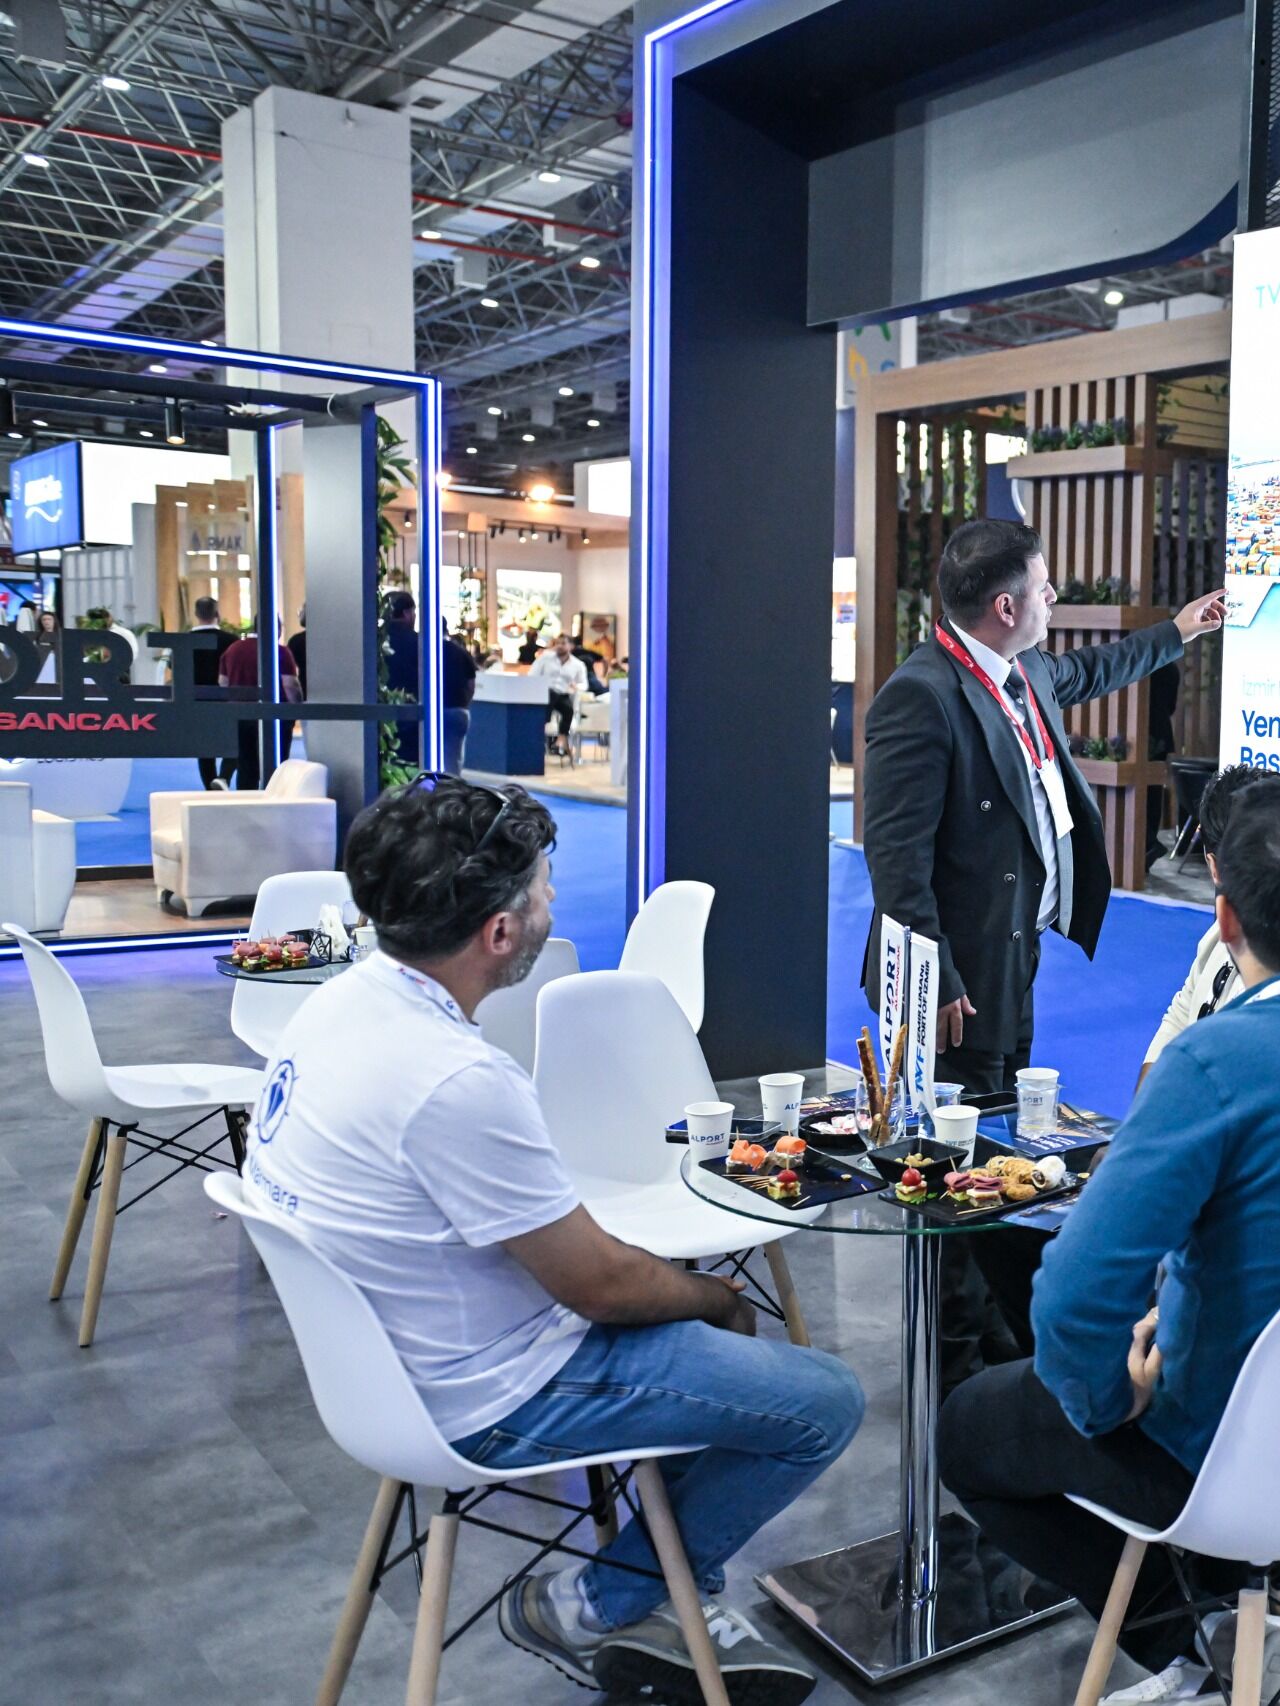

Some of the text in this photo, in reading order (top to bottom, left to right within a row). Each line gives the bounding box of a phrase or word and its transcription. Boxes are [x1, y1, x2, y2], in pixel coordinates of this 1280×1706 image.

[884, 938, 896, 1068] ALPORT
[914, 1045, 925, 1094] TVF
[690, 1132, 725, 1143] ALPORT
